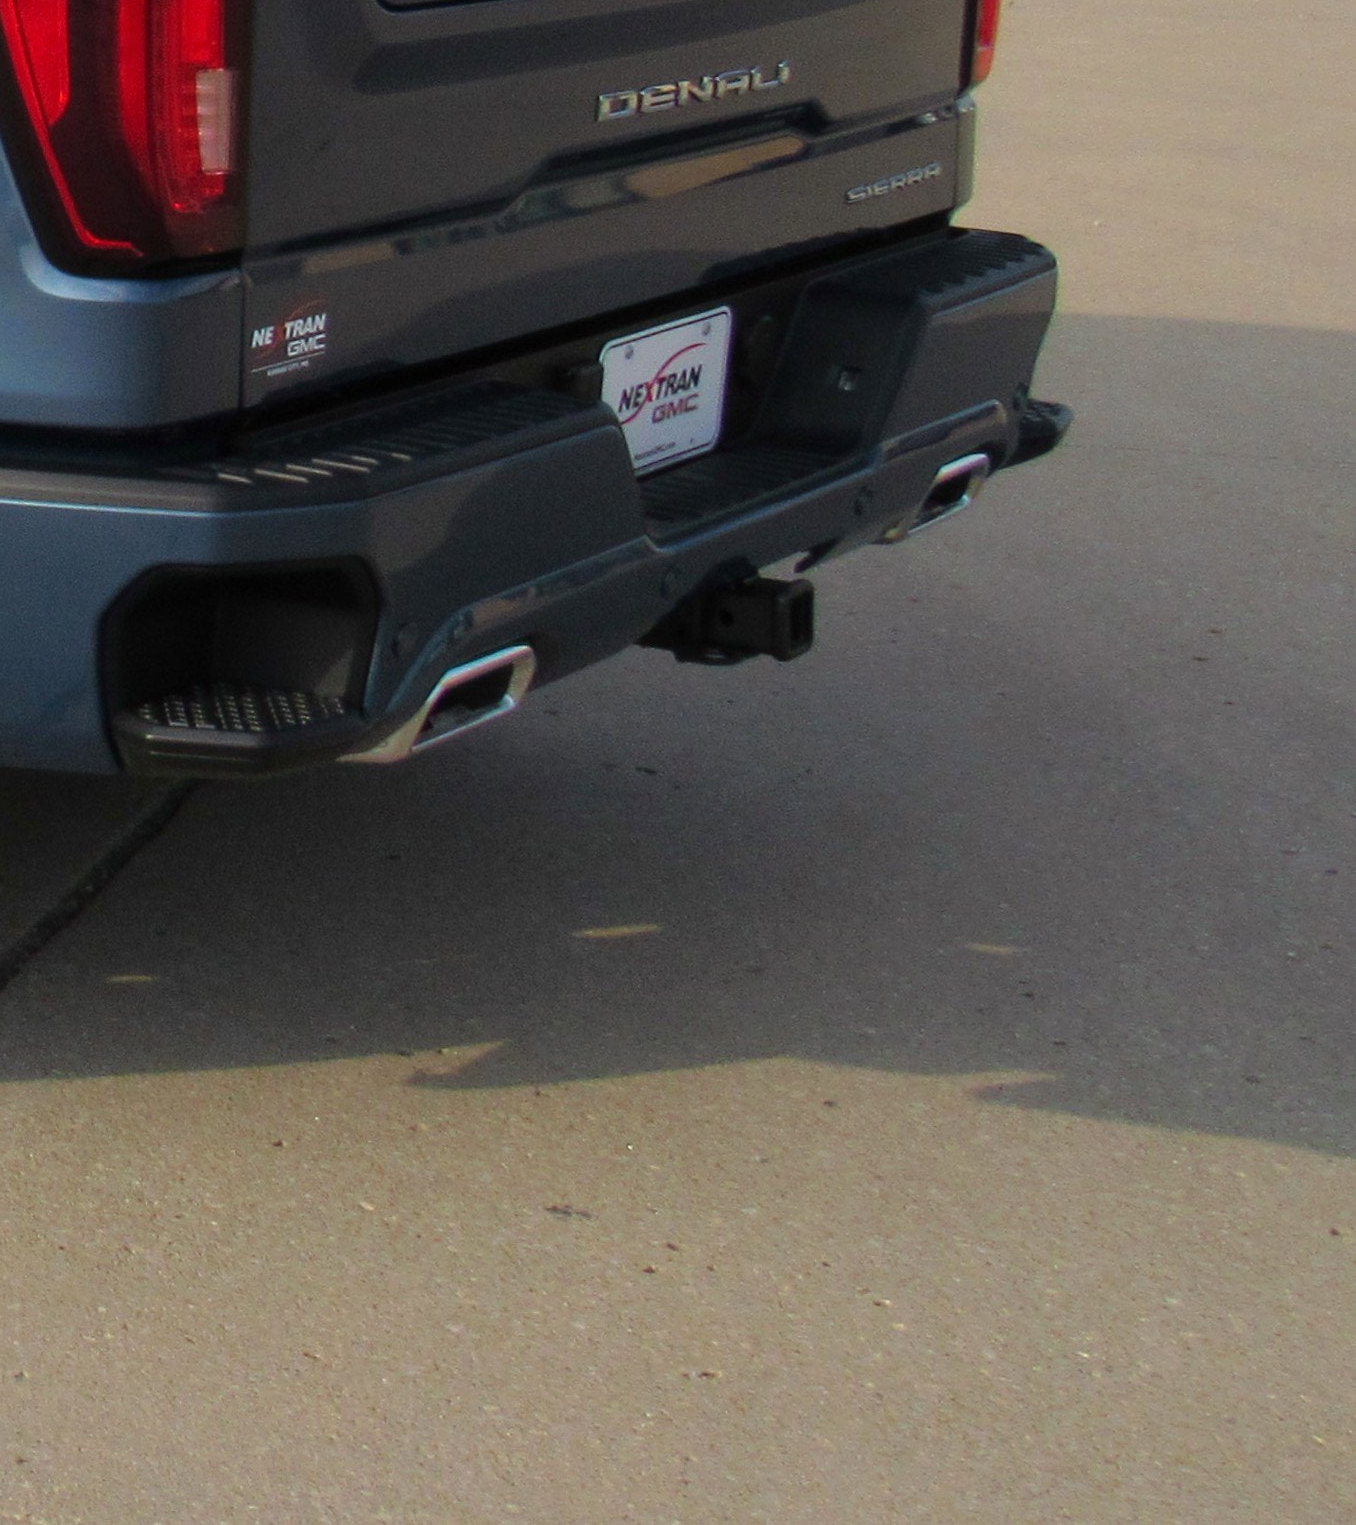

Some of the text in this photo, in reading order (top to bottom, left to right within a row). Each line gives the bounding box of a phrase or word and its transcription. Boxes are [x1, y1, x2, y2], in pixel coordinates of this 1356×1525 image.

[597, 60, 788, 122] DENALI
[846, 161, 941, 203] SIERRA
[287, 334, 326, 357] GMC
[618, 364, 703, 413] NEXTRAN
[651, 392, 700, 424] GMC
